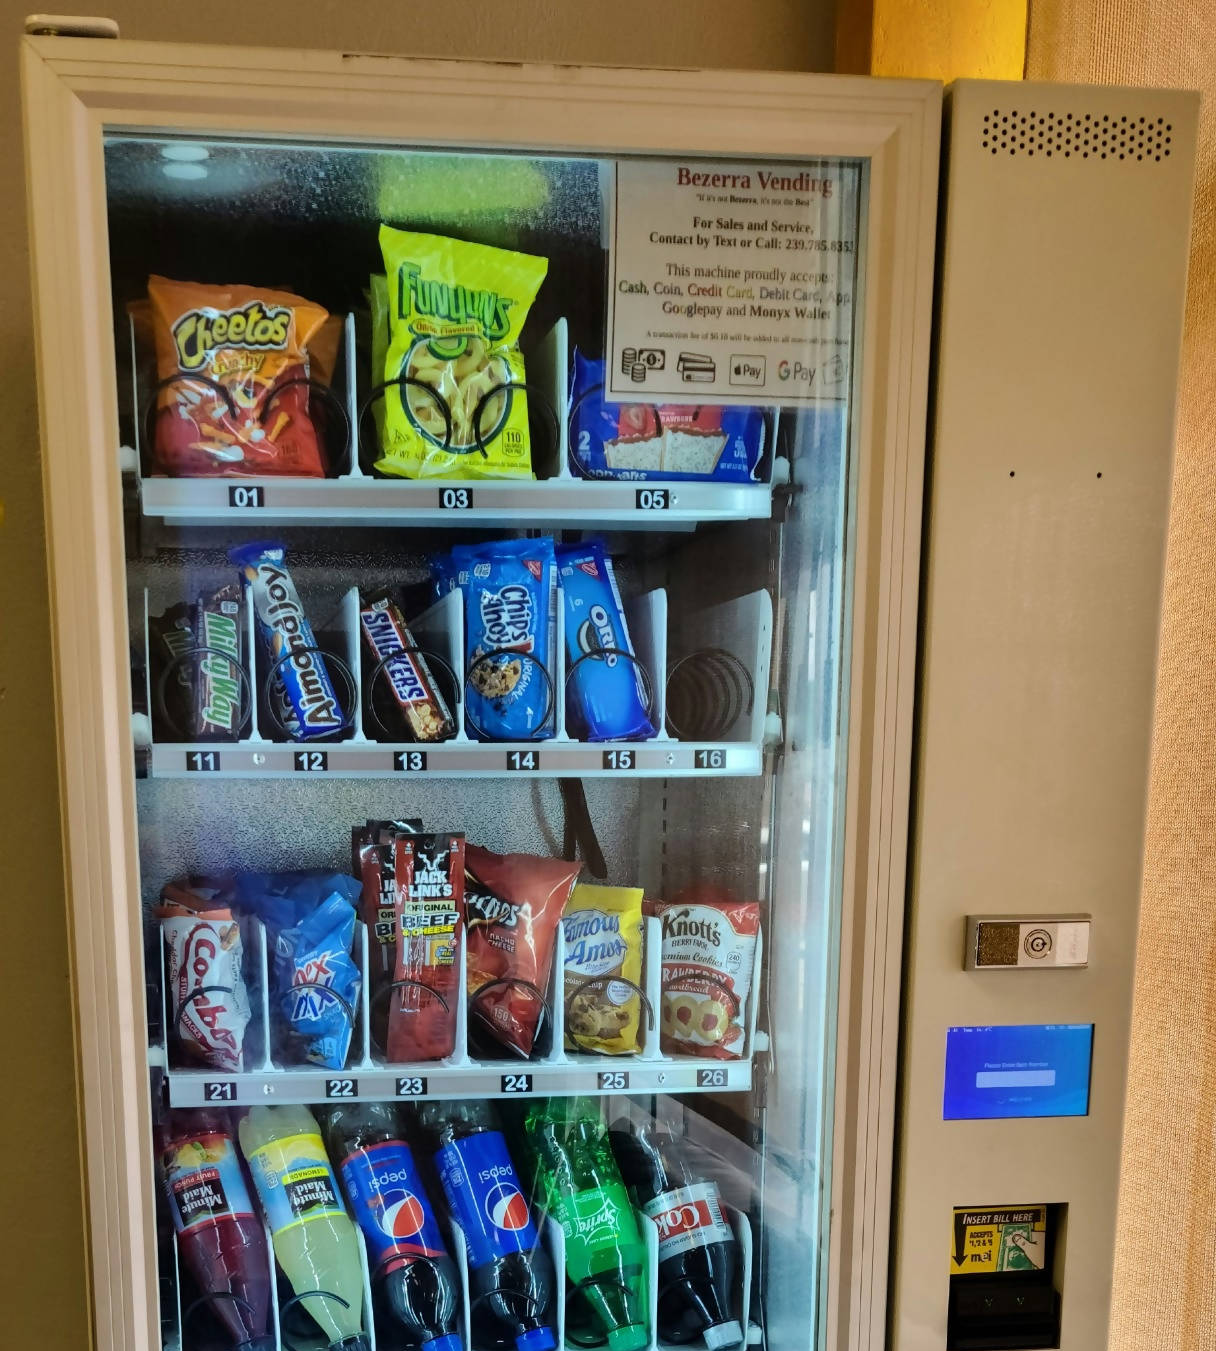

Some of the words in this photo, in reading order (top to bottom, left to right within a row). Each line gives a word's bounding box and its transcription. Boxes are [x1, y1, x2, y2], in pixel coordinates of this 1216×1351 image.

[677, 167, 750, 189] Bezerra
[757, 171, 833, 197] Vending
[693, 216, 713, 228] For
[716, 218, 744, 230] Sales
[747, 220, 768, 232] and
[771, 221, 814, 235] Service,
[650, 232, 693, 246] Contact
[696, 235, 710, 250] by
[713, 235, 737, 247] Text
[740, 238, 752, 248] or
[755, 237, 782, 249] Call:
[666, 262, 691, 277] This
[694, 265, 741, 279] machine
[744, 268, 787, 285] proudly
[619, 280, 649, 296] Cash,
[653, 281, 683, 297] Coin,
[687, 283, 722, 297] Credit
[726, 285, 755, 300] Card,
[760, 286, 790, 301] Debit
[662, 301, 722, 319] Googlepay
[727, 305, 746, 318] and
[750, 305, 791, 321] Monyx
[174, 301, 291, 370] Cheetos
[743, 363, 761, 379] Pay
[794, 362, 817, 386] Pay
[506, 432, 521, 443] 110
[578, 431, 591, 450] 2
[235, 488, 257, 507] 01
[443, 490, 469, 508] 03
[640, 491, 664, 509] 05
[500, 585, 529, 642] Chips
[201, 611, 238, 678] Milky
[362, 610, 427, 702] SNICKERS
[271, 612, 342, 727] Almond
[202, 675, 240, 730] Way
[192, 752, 215, 770] 11
[299, 753, 324, 770] 12
[399, 752, 423, 770] 13
[511, 751, 535, 770] 14
[607, 751, 632, 769] 15
[698, 751, 723, 768] 16
[414, 871, 448, 885] JACK
[408, 883, 453, 898] LINK'S
[407, 903, 453, 912] ORIGINAL
[401, 912, 460, 929] BEEF
[662, 907, 721, 947] Knott's
[412, 925, 455, 936] CHEESE
[490, 932, 515, 945] NACHO
[487, 939, 515, 953] CHEESE
[563, 939, 627, 965] Amos
[400, 1078, 423, 1095] 23
[504, 1075, 529, 1092] 24
[602, 1073, 626, 1089] 25
[702, 1070, 724, 1086] 26
[210, 1083, 233, 1100] 21
[330, 1080, 354, 1097] 22
[195, 1171, 216, 1181] FRUIT
[368, 1168, 407, 1193] pepsi
[478, 1164, 513, 1184] pepsi
[183, 1184, 213, 1203] Maid
[295, 1180, 327, 1195] Maid
[181, 1193, 223, 1214] Minute
[293, 1190, 334, 1206] Minute
[579, 1208, 616, 1233] Sprite
[655, 1205, 700, 1236] Cok
[963, 1213, 990, 1225] INSERT
[993, 1213, 1009, 1223] BILL
[1013, 1213, 1034, 1222] HERE
[969, 1230, 994, 1238] ACCEPTS
[971, 1250, 992, 1263] mei
